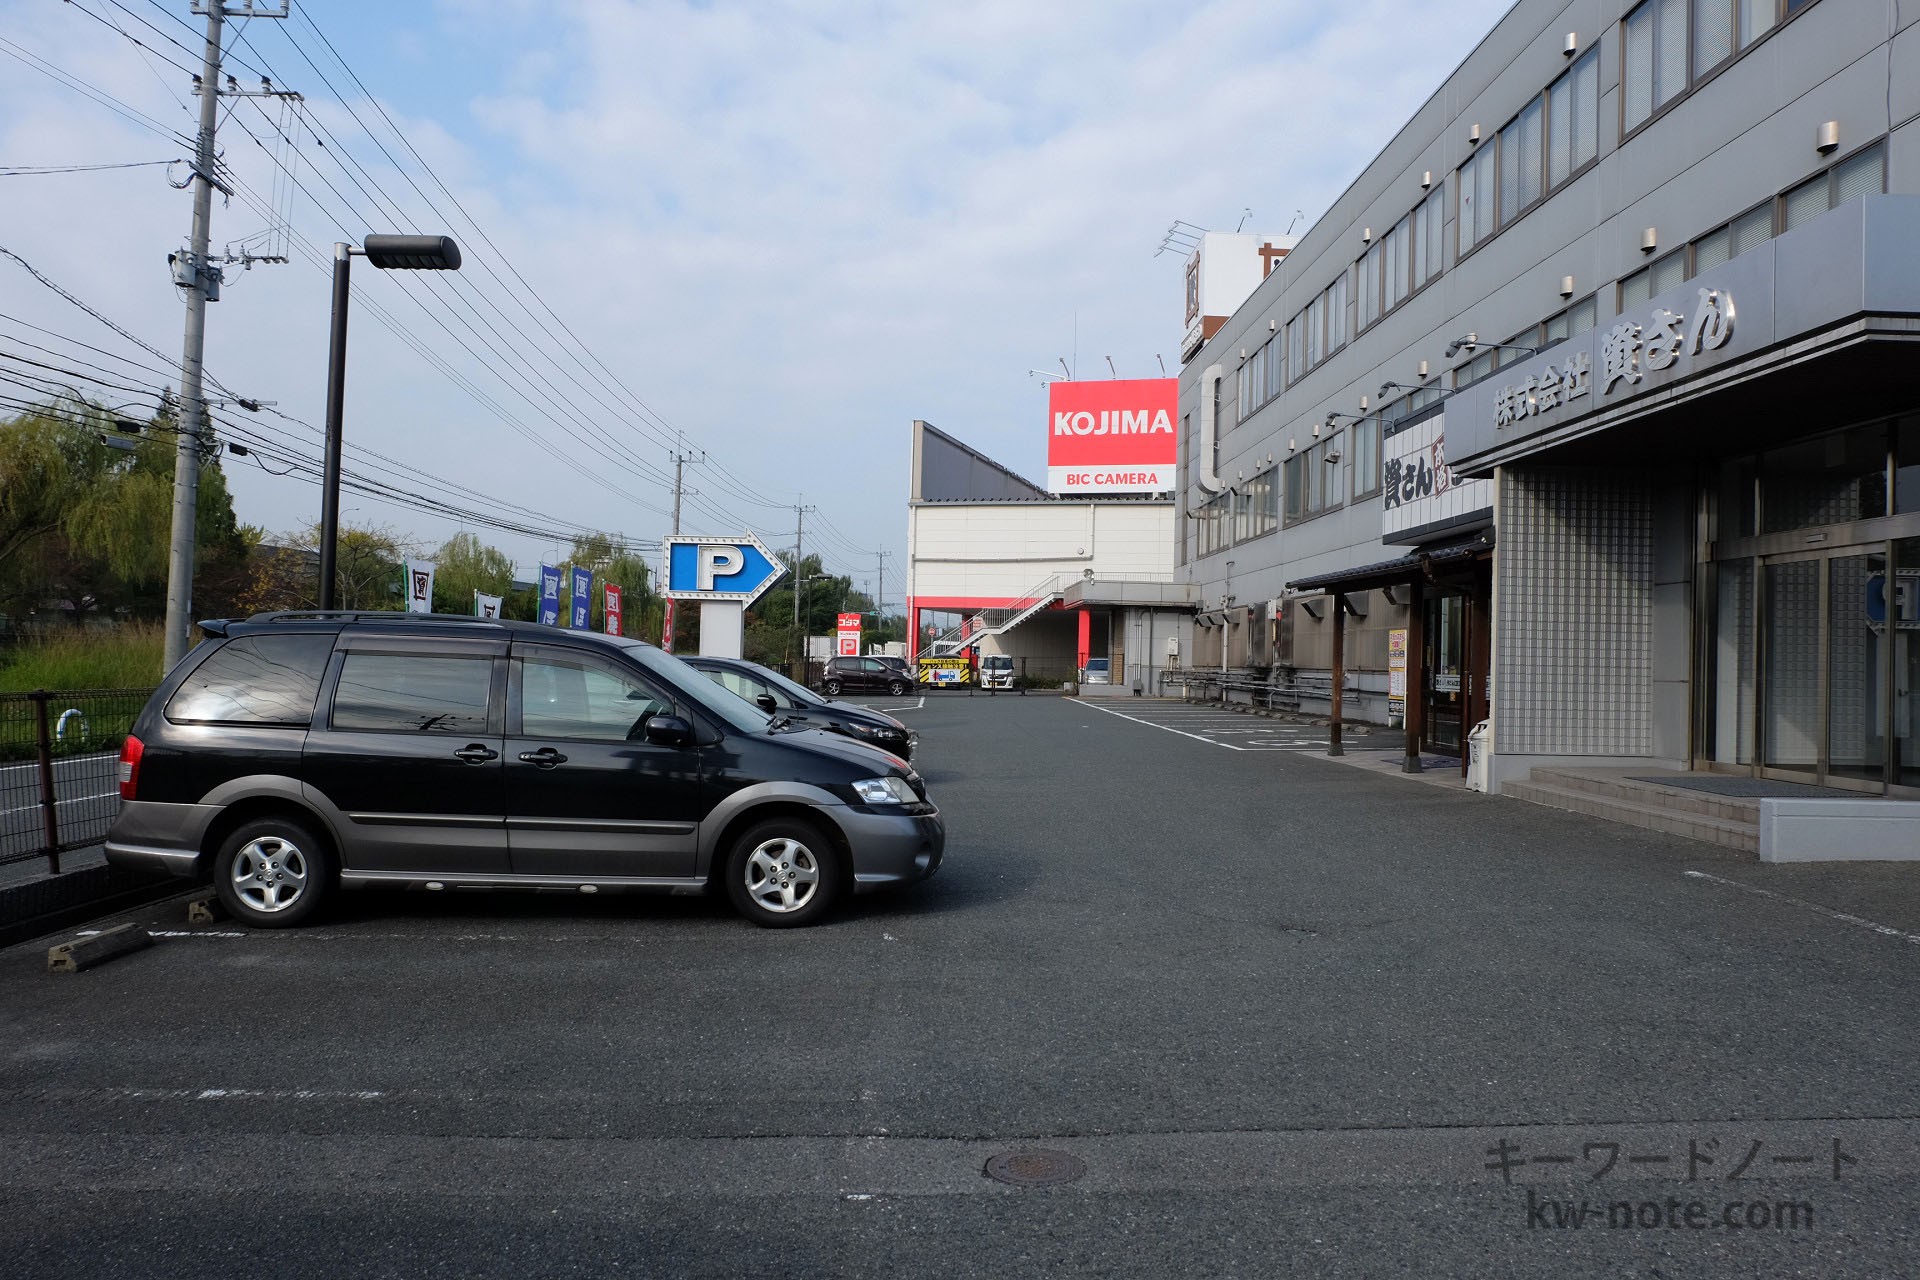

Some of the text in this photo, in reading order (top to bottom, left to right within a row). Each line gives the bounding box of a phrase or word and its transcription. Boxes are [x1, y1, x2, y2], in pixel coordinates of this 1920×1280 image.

[1492, 287, 1736, 430] 株式会社 資さん
[1054, 409, 1173, 436] KOJIMA
[1066, 472, 1158, 486] BIC CAMERA
[1384, 455, 1433, 511] 資さん
[696, 544, 744, 591] P
[842, 639, 855, 655] P
